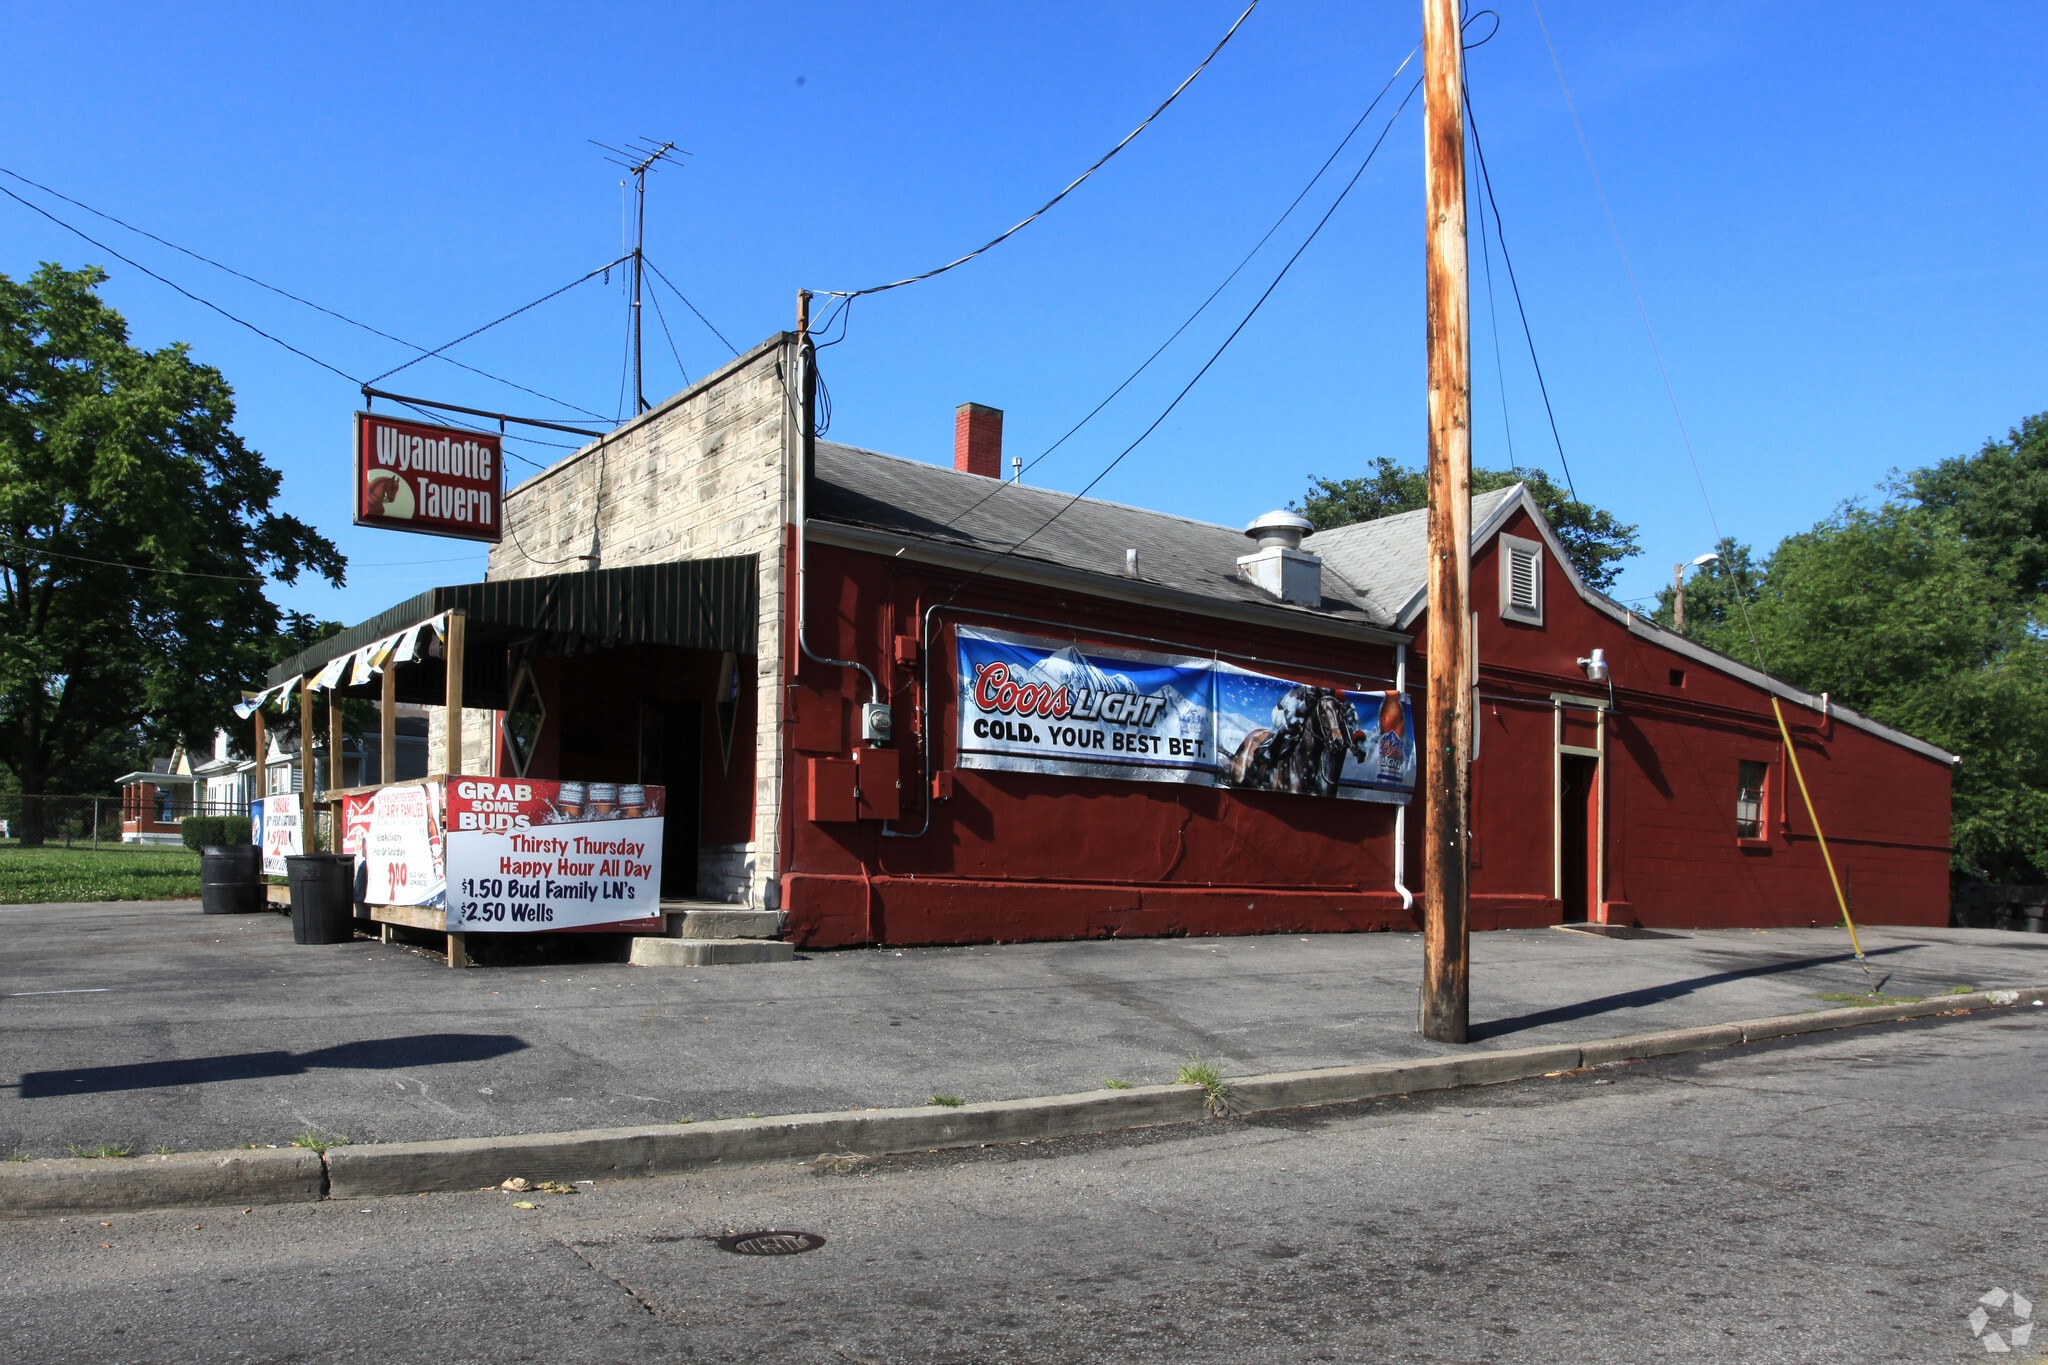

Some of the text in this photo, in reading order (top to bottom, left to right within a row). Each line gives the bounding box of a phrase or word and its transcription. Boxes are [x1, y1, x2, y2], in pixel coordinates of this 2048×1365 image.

[376, 425, 491, 481] Wyandotte
[417, 477, 491, 525] Tavern
[974, 662, 1166, 727] Coors LIGHT
[973, 718, 1206, 758] COLD. YOUR BEST BET.
[457, 781, 532, 802] GRAB
[471, 800, 519, 813] SOME
[459, 812, 531, 832] BUDS
[510, 834, 645, 859] Thirsty Thursday
[500, 856, 652, 880] Happy Hour All Day
[462, 878, 635, 902] $1.50 Bud Family LN's
[461, 902, 554, 922] $2.50 Wells
